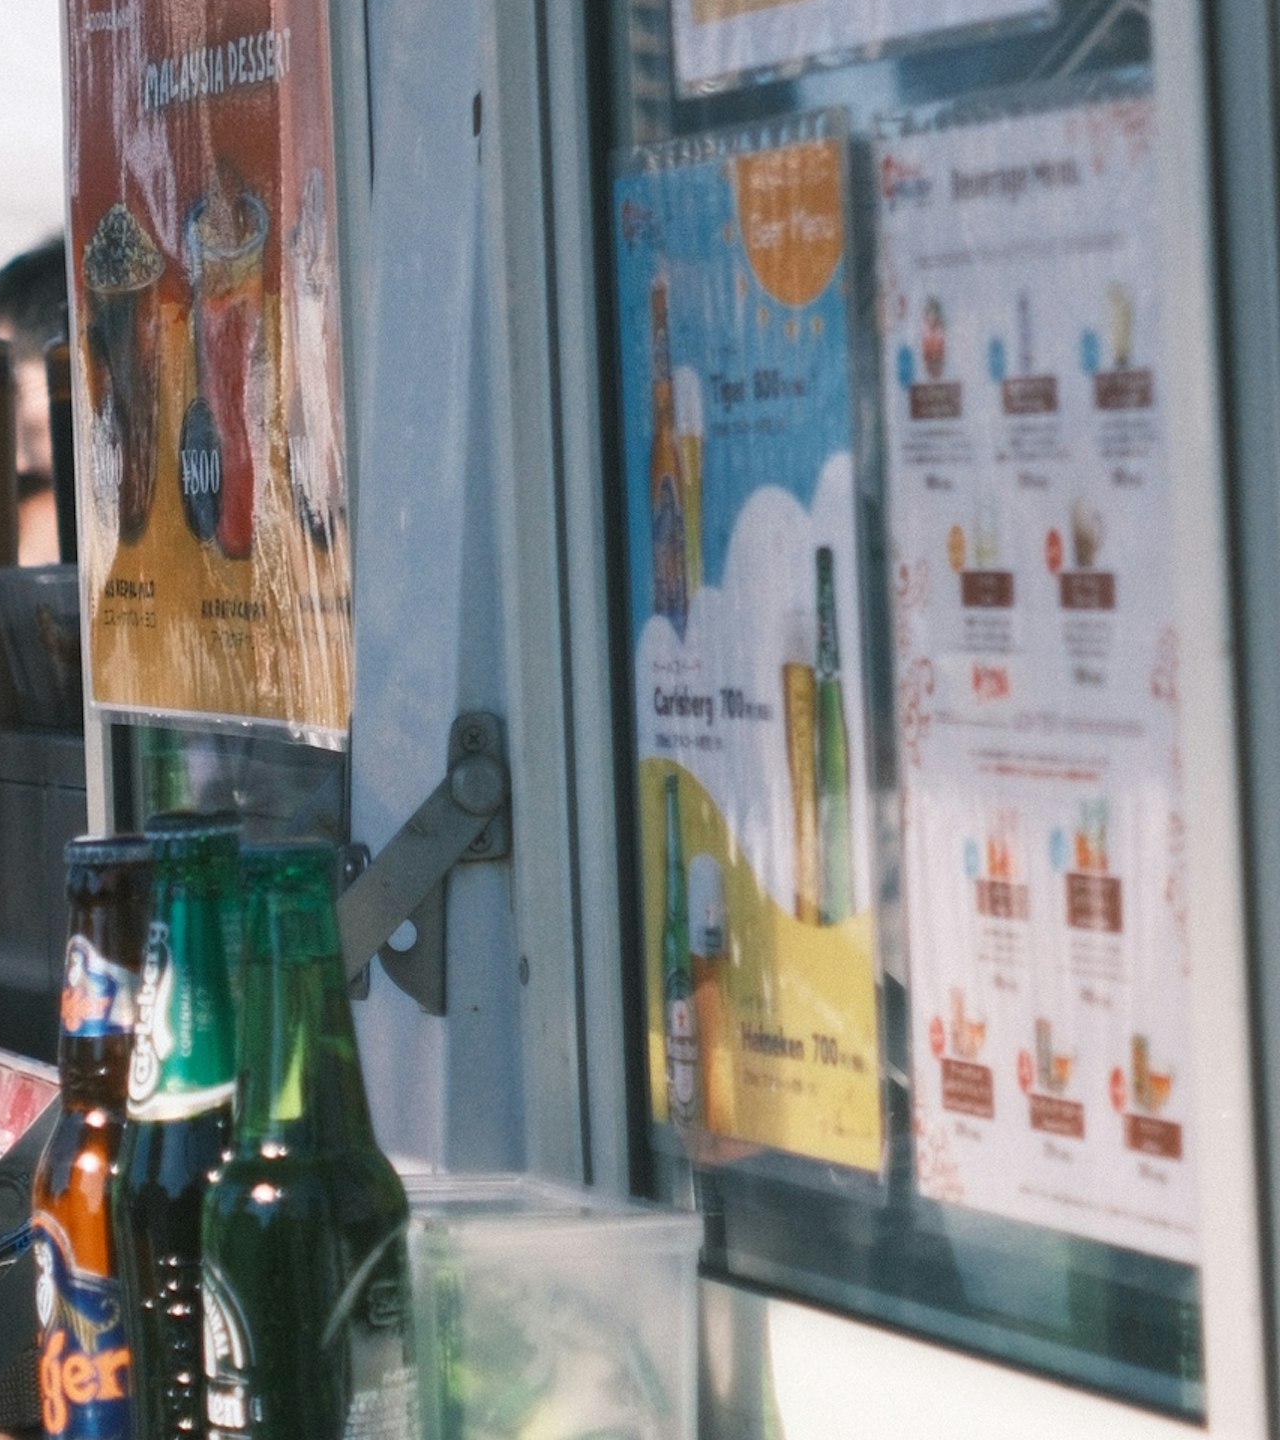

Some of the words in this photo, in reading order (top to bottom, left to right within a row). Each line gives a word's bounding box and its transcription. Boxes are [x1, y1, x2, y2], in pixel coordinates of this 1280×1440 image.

[144, 44, 224, 110] MALAYSIA
[228, 27, 291, 85] DESSERT
[951, 167, 1026, 206] Beverage
[181, 449, 221, 495] ¥800
[654, 684, 714, 727] Carlsberg
[720, 688, 744, 719] 700
[127, 921, 170, 1102] Carlsberg
[740, 1021, 805, 1061] Heineken
[812, 1033, 839, 1067] 700
[30, 1327, 135, 1435] ger
